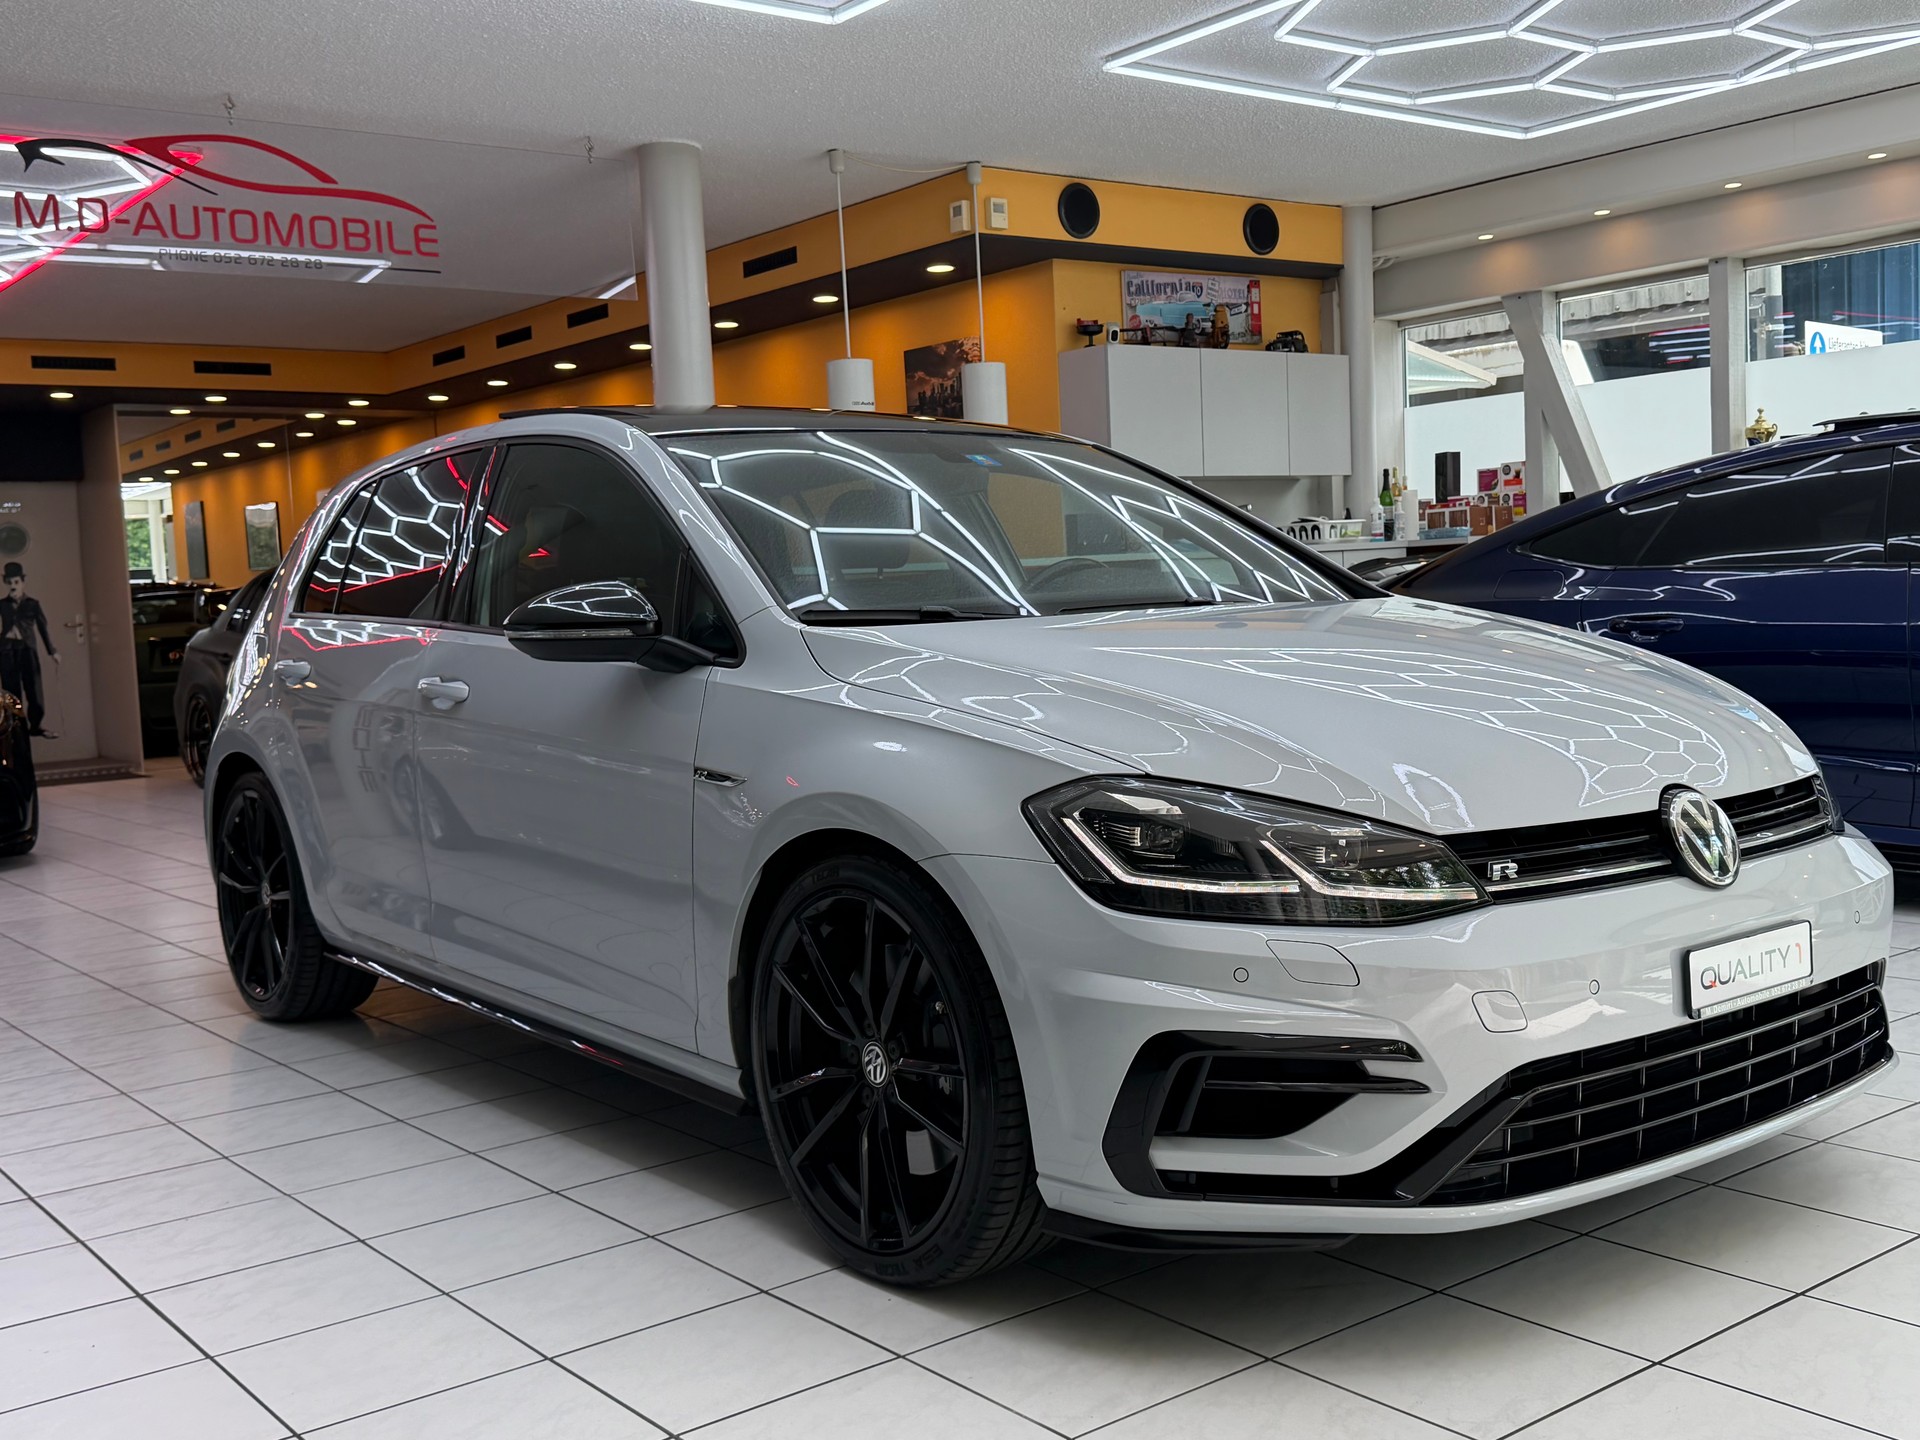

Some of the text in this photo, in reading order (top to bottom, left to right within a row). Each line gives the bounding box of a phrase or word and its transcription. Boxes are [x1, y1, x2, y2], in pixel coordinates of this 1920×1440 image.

[14, 190, 440, 258] M.D-AUTOMOBILE
[158, 248, 323, 270] PHONE 052 672 28 28
[1127, 278, 1192, 298] California
[1488, 859, 1519, 881] R
[1700, 942, 1802, 990] QUALITY 1
[1737, 990, 1770, 1007] Automobile
